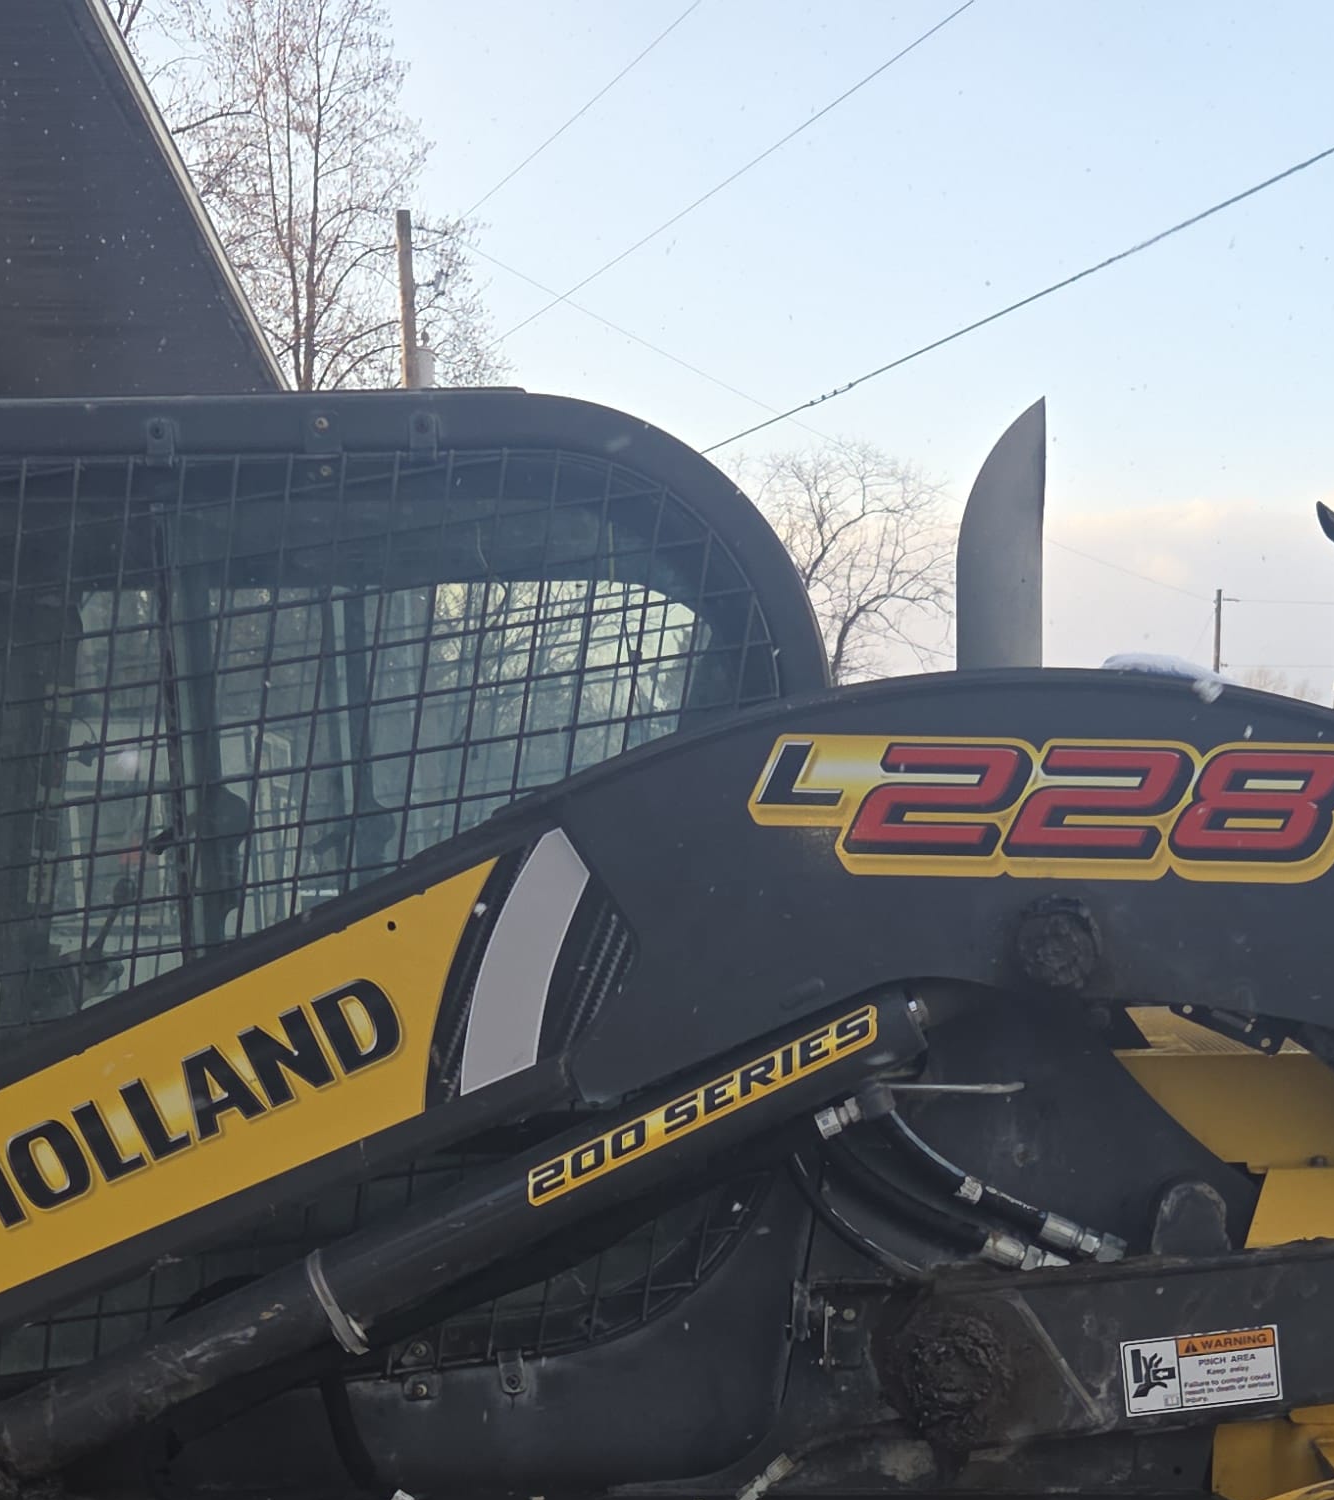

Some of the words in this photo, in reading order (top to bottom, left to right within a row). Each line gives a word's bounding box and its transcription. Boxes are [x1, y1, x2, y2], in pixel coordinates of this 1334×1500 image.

[531, 1118, 647, 1200] 200
[663, 1006, 873, 1136] SERIES
[1200, 1333, 1268, 1350] WARNING
[1198, 1356, 1227, 1367] PINCH
[1230, 1353, 1256, 1363] AREA
